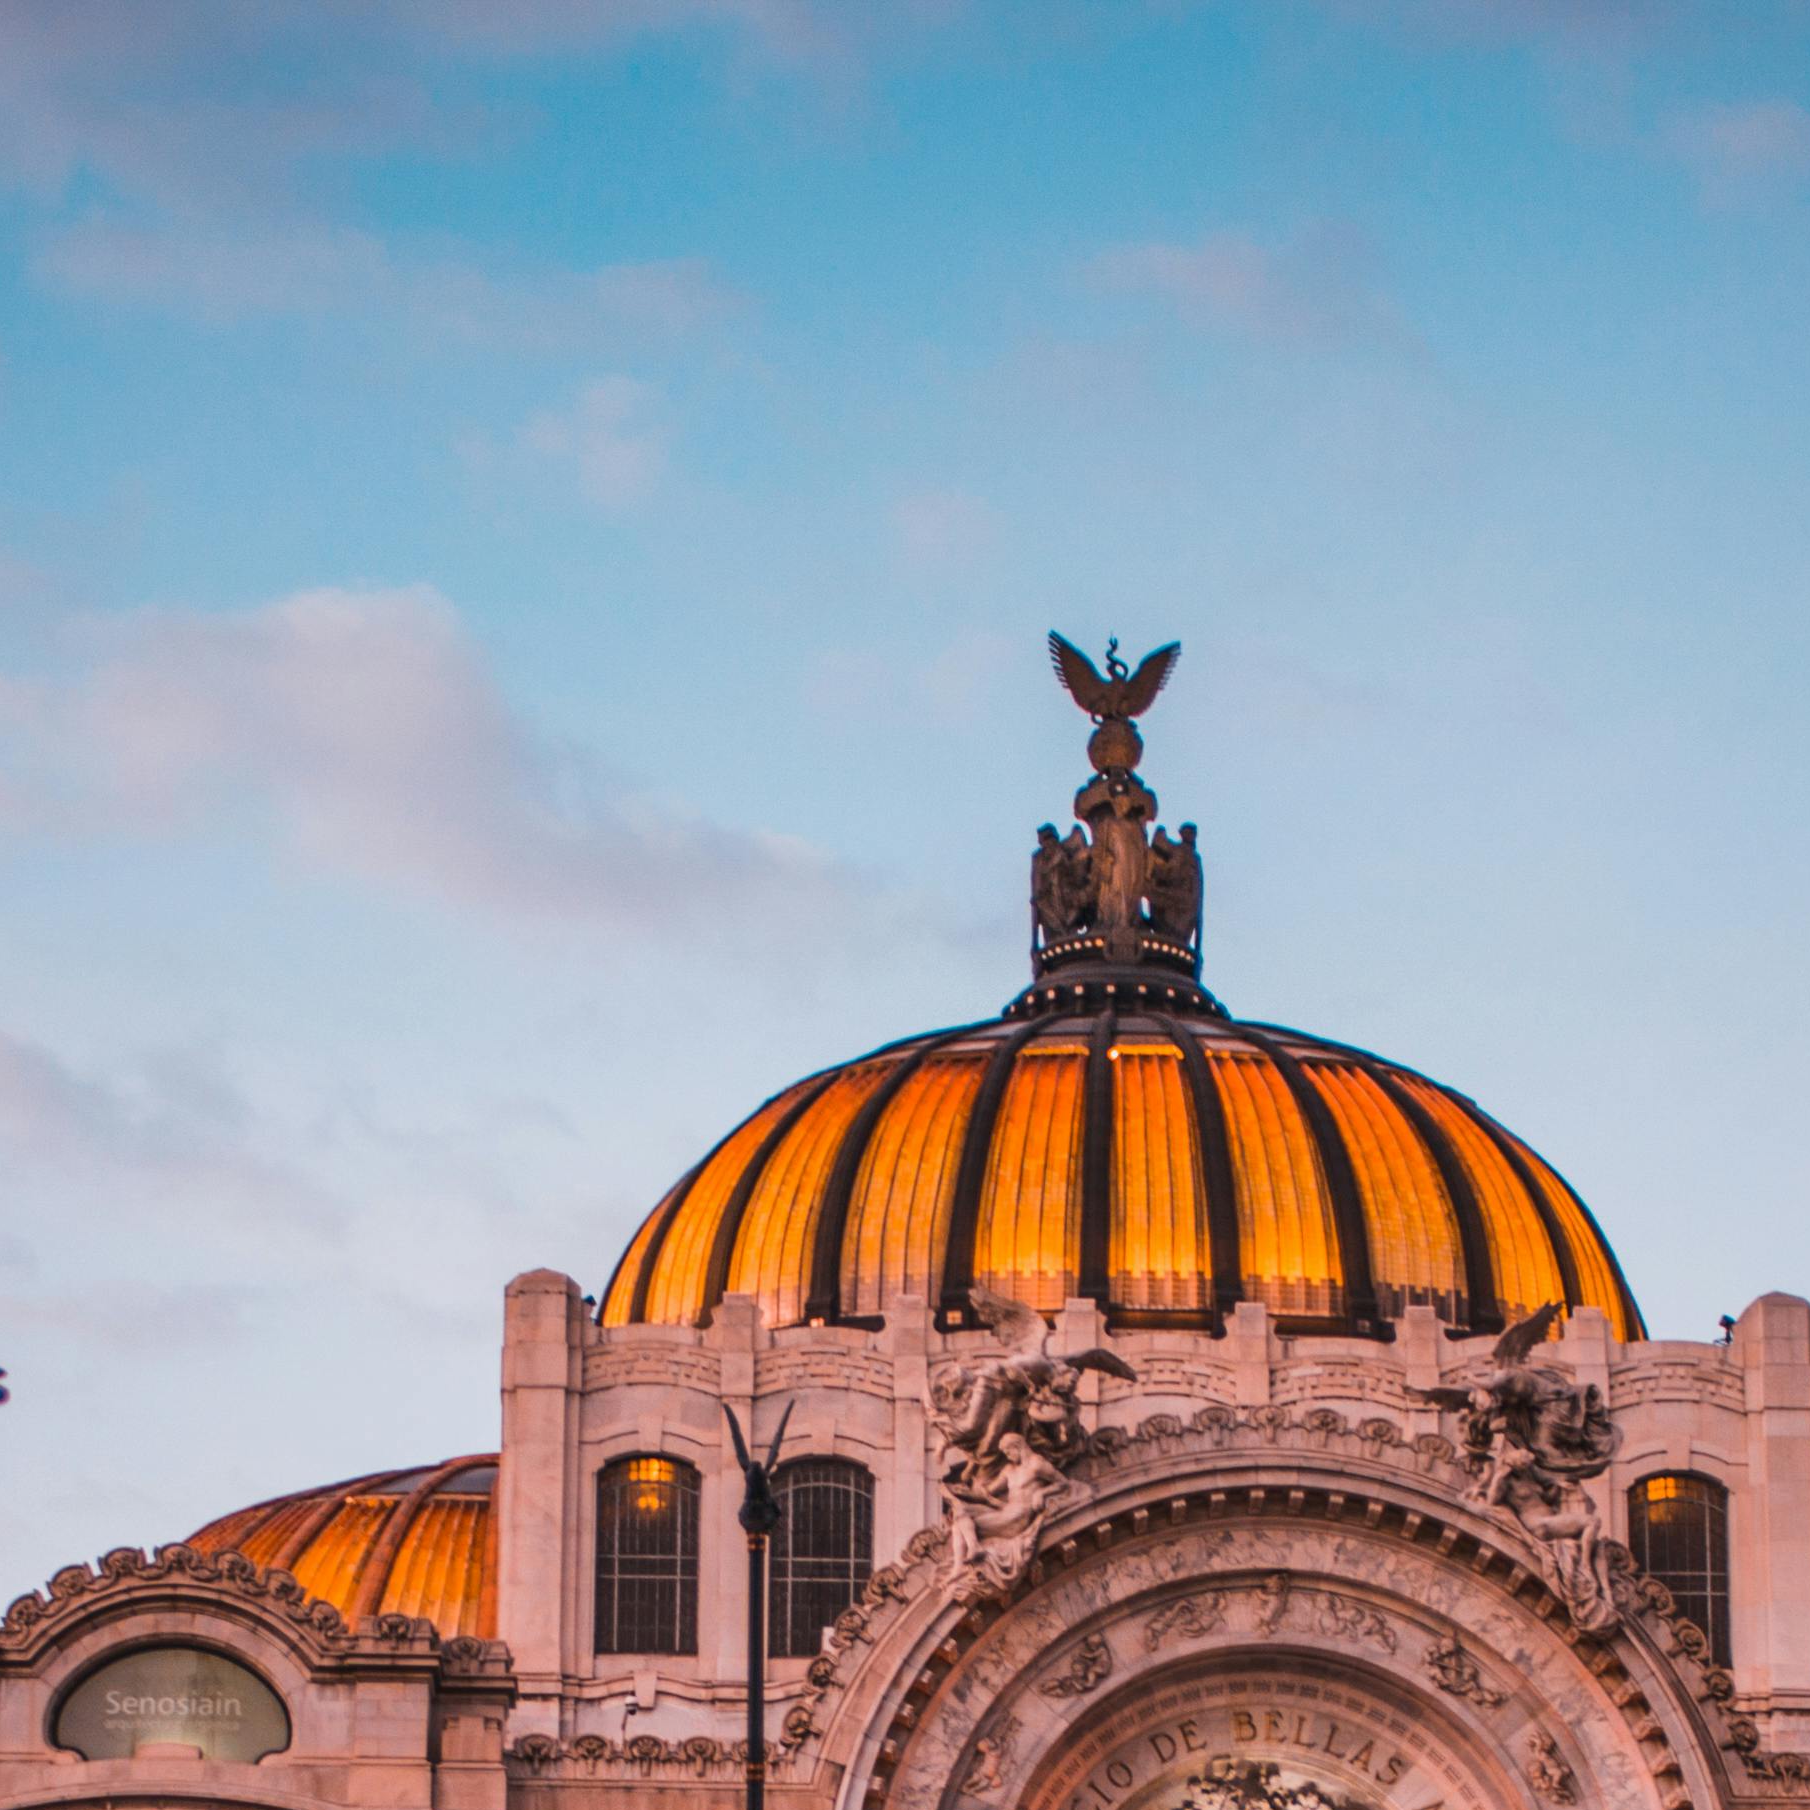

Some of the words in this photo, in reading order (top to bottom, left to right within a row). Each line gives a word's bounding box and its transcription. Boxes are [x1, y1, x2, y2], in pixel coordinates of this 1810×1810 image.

[106, 1690, 242, 1716] Senosiain
[1149, 1719, 1207, 1764] DE
[1233, 1710, 1405, 1785] BELLAS
